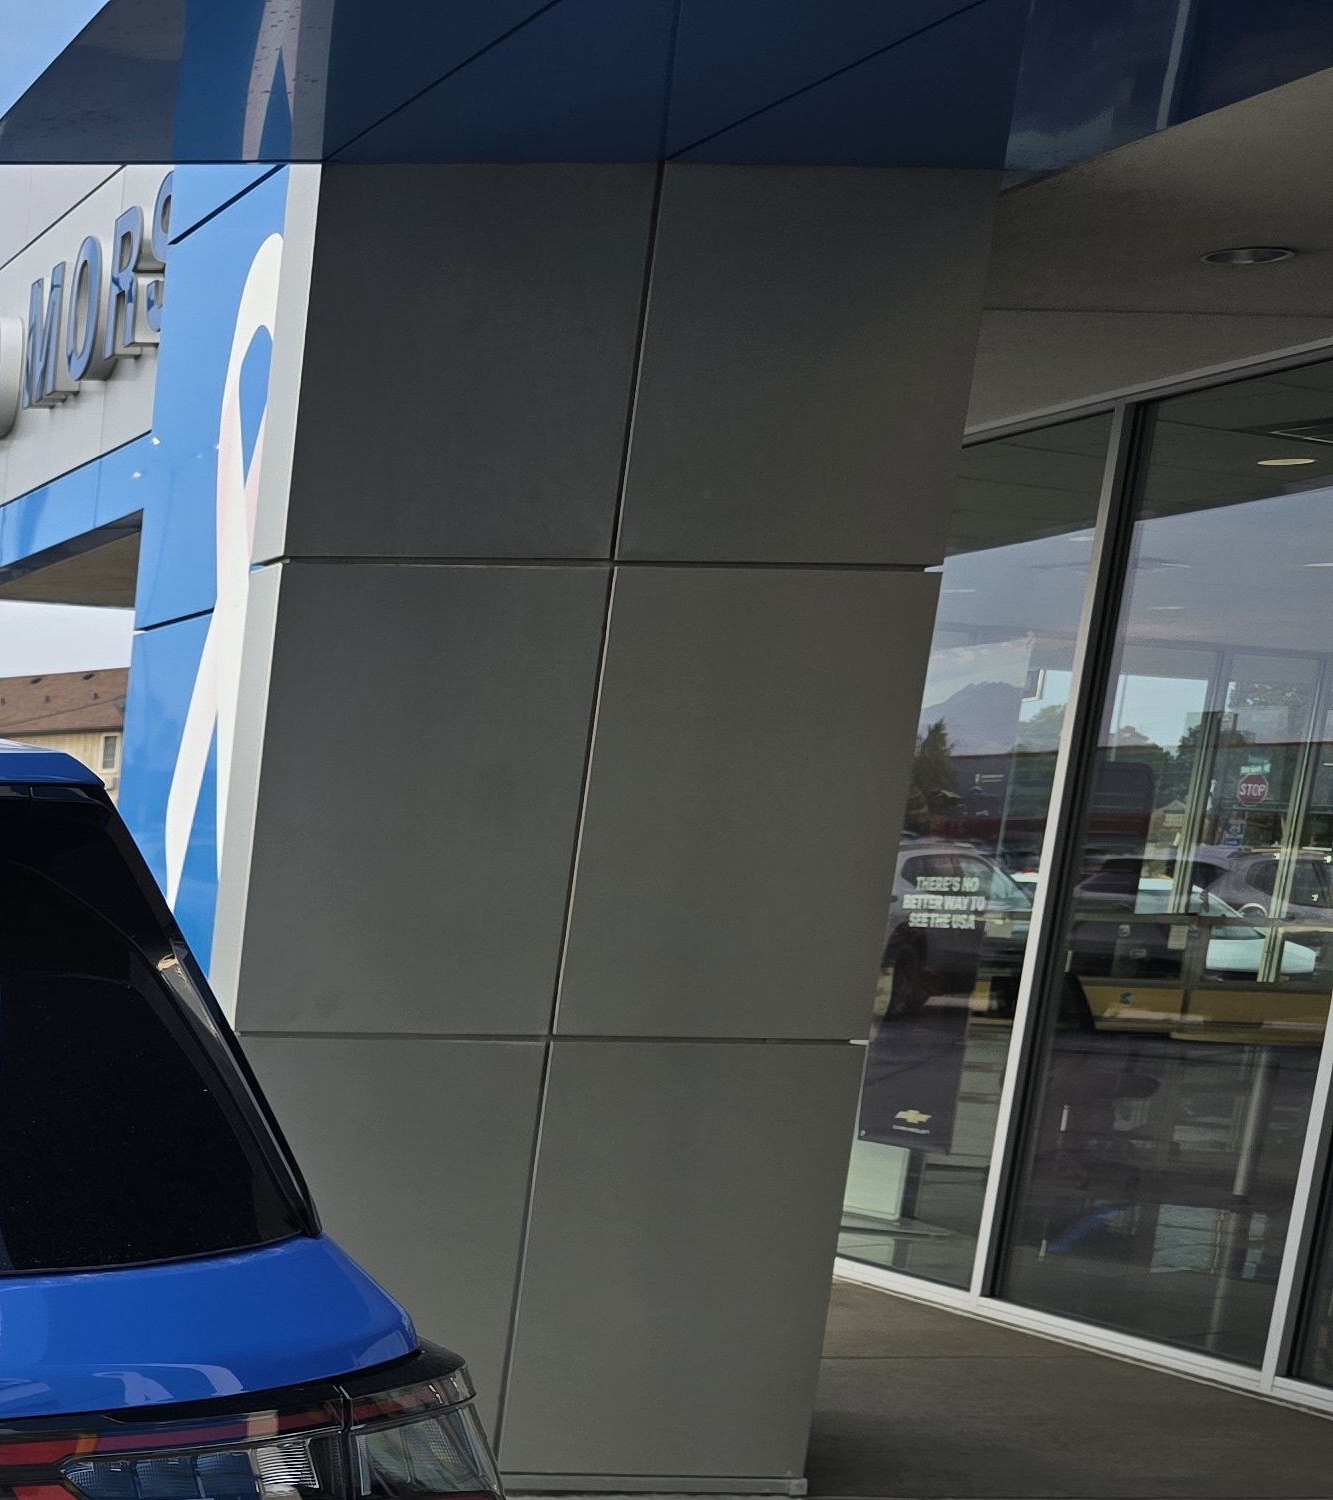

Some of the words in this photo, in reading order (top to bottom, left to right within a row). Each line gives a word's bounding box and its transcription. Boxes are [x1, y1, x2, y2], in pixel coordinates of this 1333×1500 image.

[1240, 783, 1266, 796] STOP
[915, 876, 961, 892] THERE'S
[961, 877, 980, 892] NO
[902, 894, 944, 909] BETTER
[943, 895, 970, 911] WAY
[970, 896, 986, 912] TO
[909, 913, 929, 927] SEE
[929, 914, 952, 928] THE
[952, 914, 975, 929] USA
